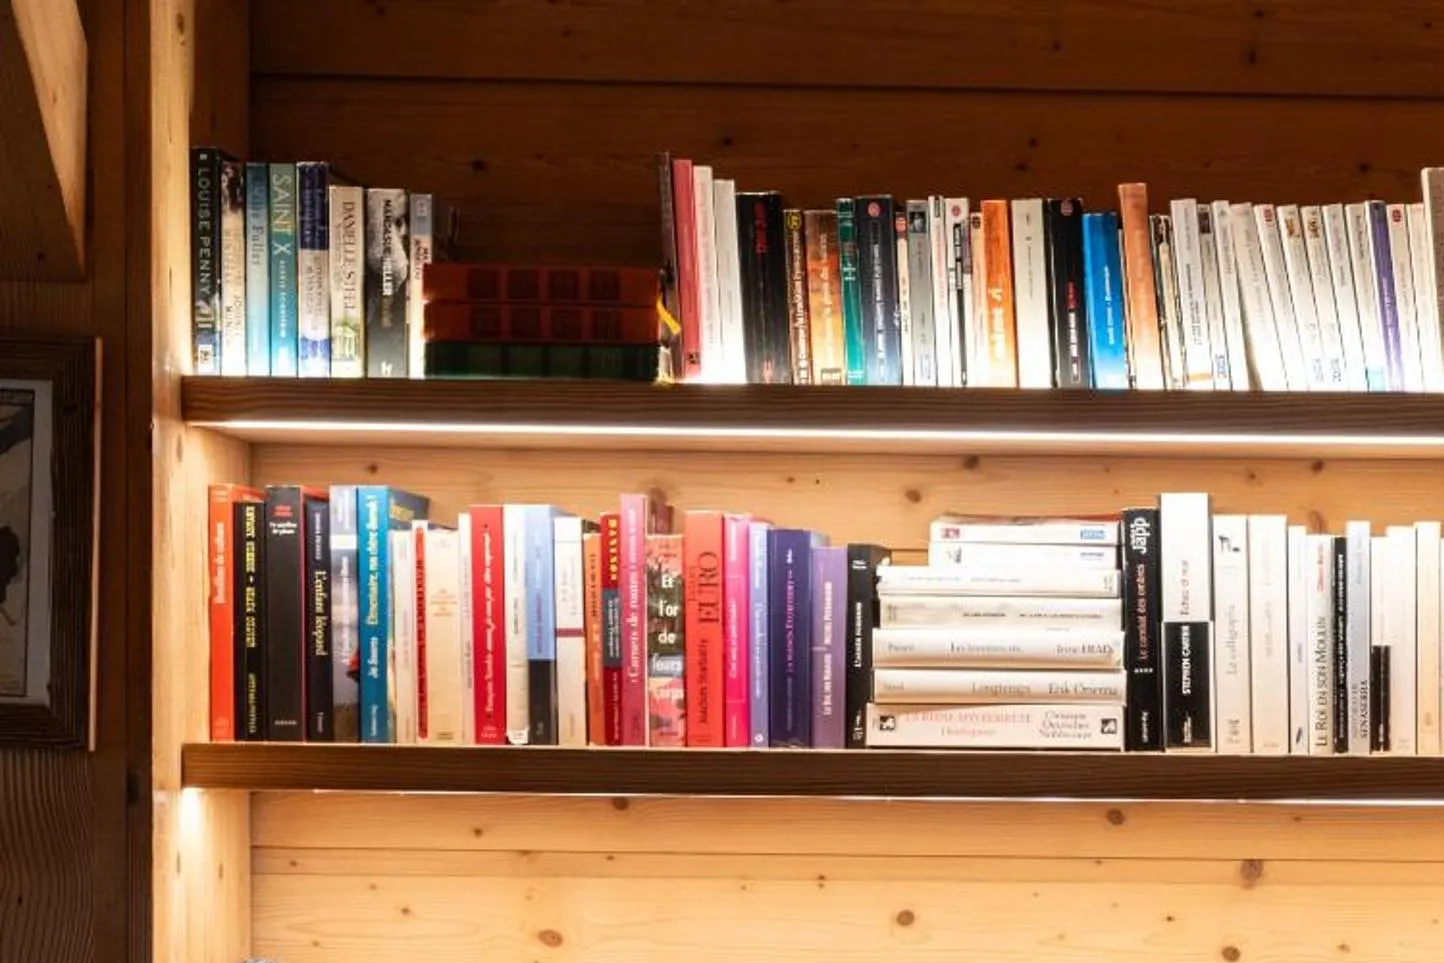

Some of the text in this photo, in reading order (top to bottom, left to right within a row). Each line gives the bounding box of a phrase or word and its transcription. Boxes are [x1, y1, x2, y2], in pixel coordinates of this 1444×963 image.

[198, 167, 212, 295] LOUISE PENNY
[272, 174, 293, 256] SAINT X
[342, 201, 356, 263] DANIELLE
[1131, 517, 1150, 555] Japp
[699, 551, 719, 624] EURO
